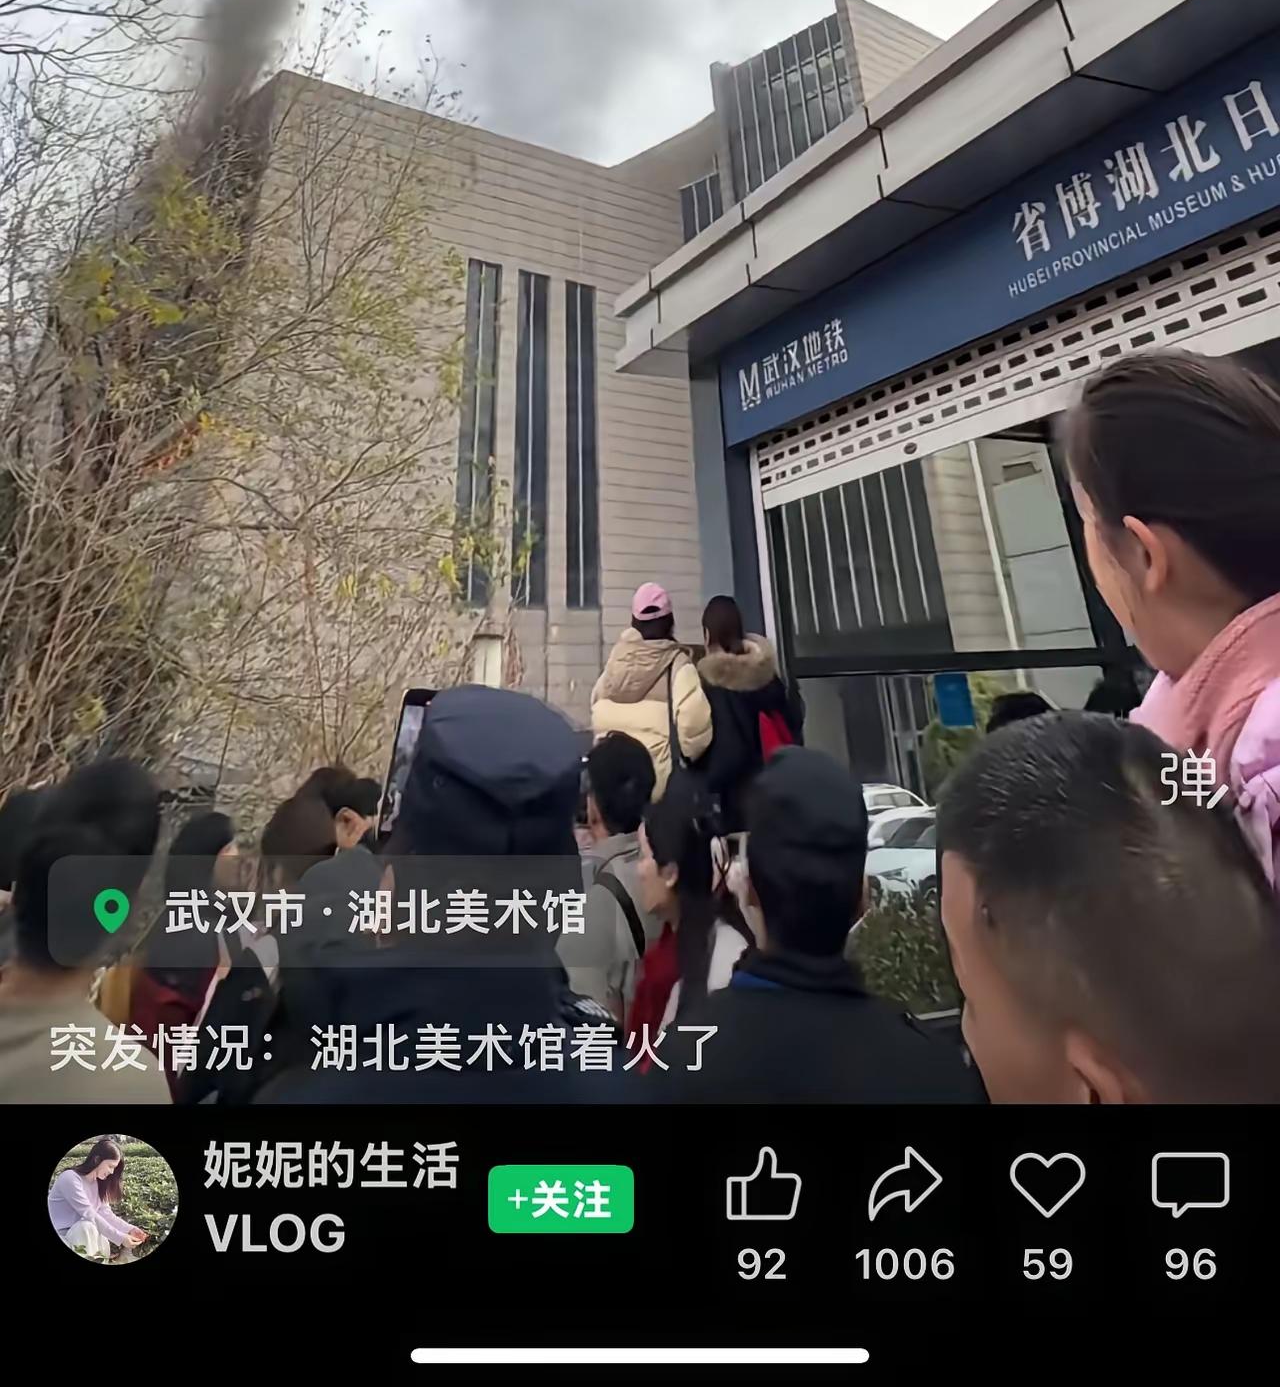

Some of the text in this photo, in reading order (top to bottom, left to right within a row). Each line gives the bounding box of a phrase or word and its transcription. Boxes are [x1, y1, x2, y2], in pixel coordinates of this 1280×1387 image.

[1011, 80, 1280, 261] 省博湖北日
[1008, 268, 1051, 298] HUBEI
[1053, 222, 1148, 277] PROVINCIAL
[1148, 181, 1228, 231] MUSEUM
[1230, 174, 1246, 192] &
[762, 318, 845, 385] 武汉地铁
[765, 348, 848, 399] WUHAN METRO
